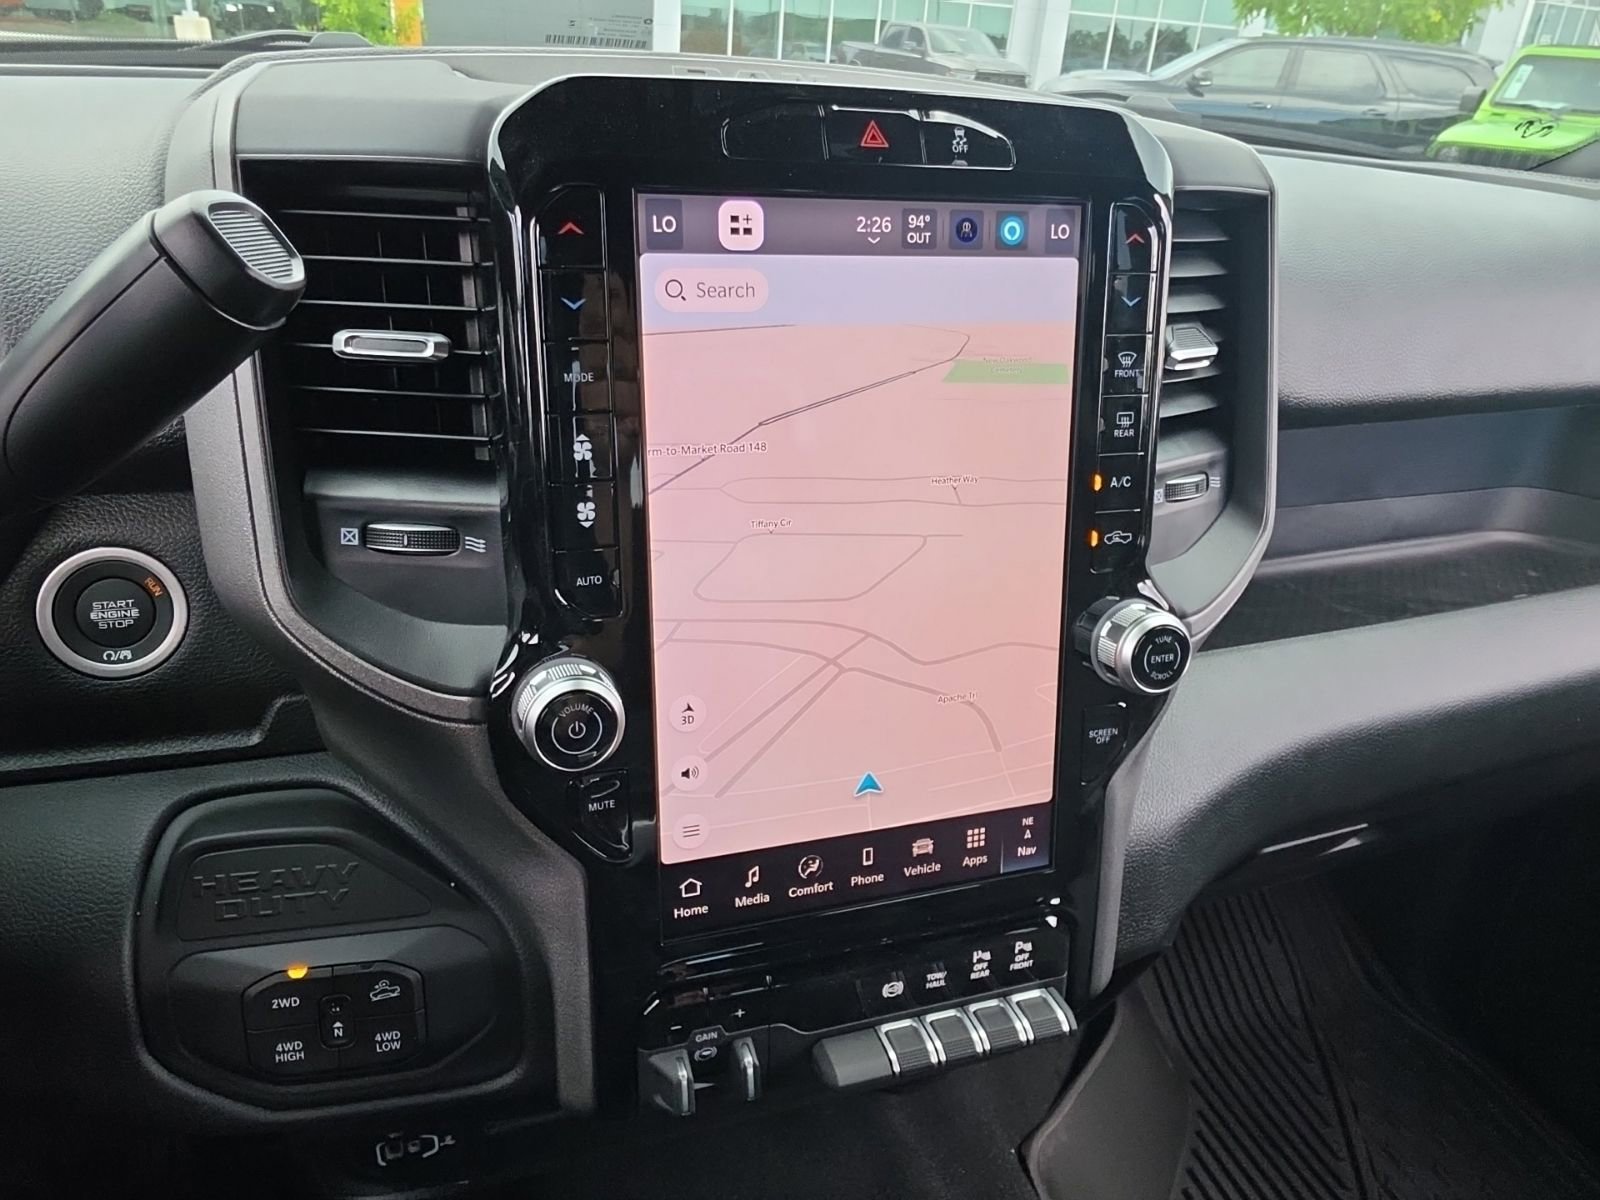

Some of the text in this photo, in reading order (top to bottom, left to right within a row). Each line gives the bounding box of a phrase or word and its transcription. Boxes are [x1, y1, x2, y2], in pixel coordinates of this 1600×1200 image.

[951, 144, 969, 154] OFF
[652, 215, 677, 233] LO
[856, 216, 892, 233] 2:26
[1051, 224, 1070, 240] LO
[907, 232, 932, 244] OUT
[696, 281, 756, 299] Search
[564, 372, 595, 383] MODE
[1114, 368, 1140, 378] FRONT
[1113, 428, 1135, 438] REAR
[719, 444, 746, 454] Road
[748, 442, 768, 452] 148
[931, 475, 978, 485] Heather Way
[1110, 476, 1132, 488] A/C
[751, 518, 792, 529] Tiffany Cir
[576, 575, 603, 587] AUTO
[143, 577, 163, 597] RUN
[92, 600, 135, 610] START
[90, 609, 140, 620] ENGINE
[97, 619, 134, 629] STOP
[1155, 636, 1173, 644] TUNE
[1151, 653, 1175, 663] ENTER
[558, 703, 594, 718] VOLUME
[681, 715, 694, 725] 3D
[1089, 728, 1118, 738] SCREEN
[1096, 736, 1111, 744] OFF
[588, 800, 616, 812] MUTE
[1022, 816, 1035, 827] NE
[1017, 845, 1037, 857] Nav
[962, 854, 988, 868] Apps
[903, 862, 942, 877] Vehicle
[850, 872, 885, 887] Phone
[788, 881, 834, 898] Comfort
[734, 893, 771, 908] Media
[673, 904, 709, 919] Home
[1014, 952, 1030, 962] OFF
[972, 962, 988, 971] OFF
[1009, 960, 1033, 971] FRONT
[970, 969, 990, 980] REAR
[271, 997, 300, 1009] 2WD
[334, 1028, 343, 1037] N
[375, 1031, 400, 1042] 4WD
[695, 1032, 718, 1043] GAIN
[275, 1041, 303, 1052] 4WD
[376, 1041, 401, 1053] LOW
[275, 1051, 305, 1063] HIGH
